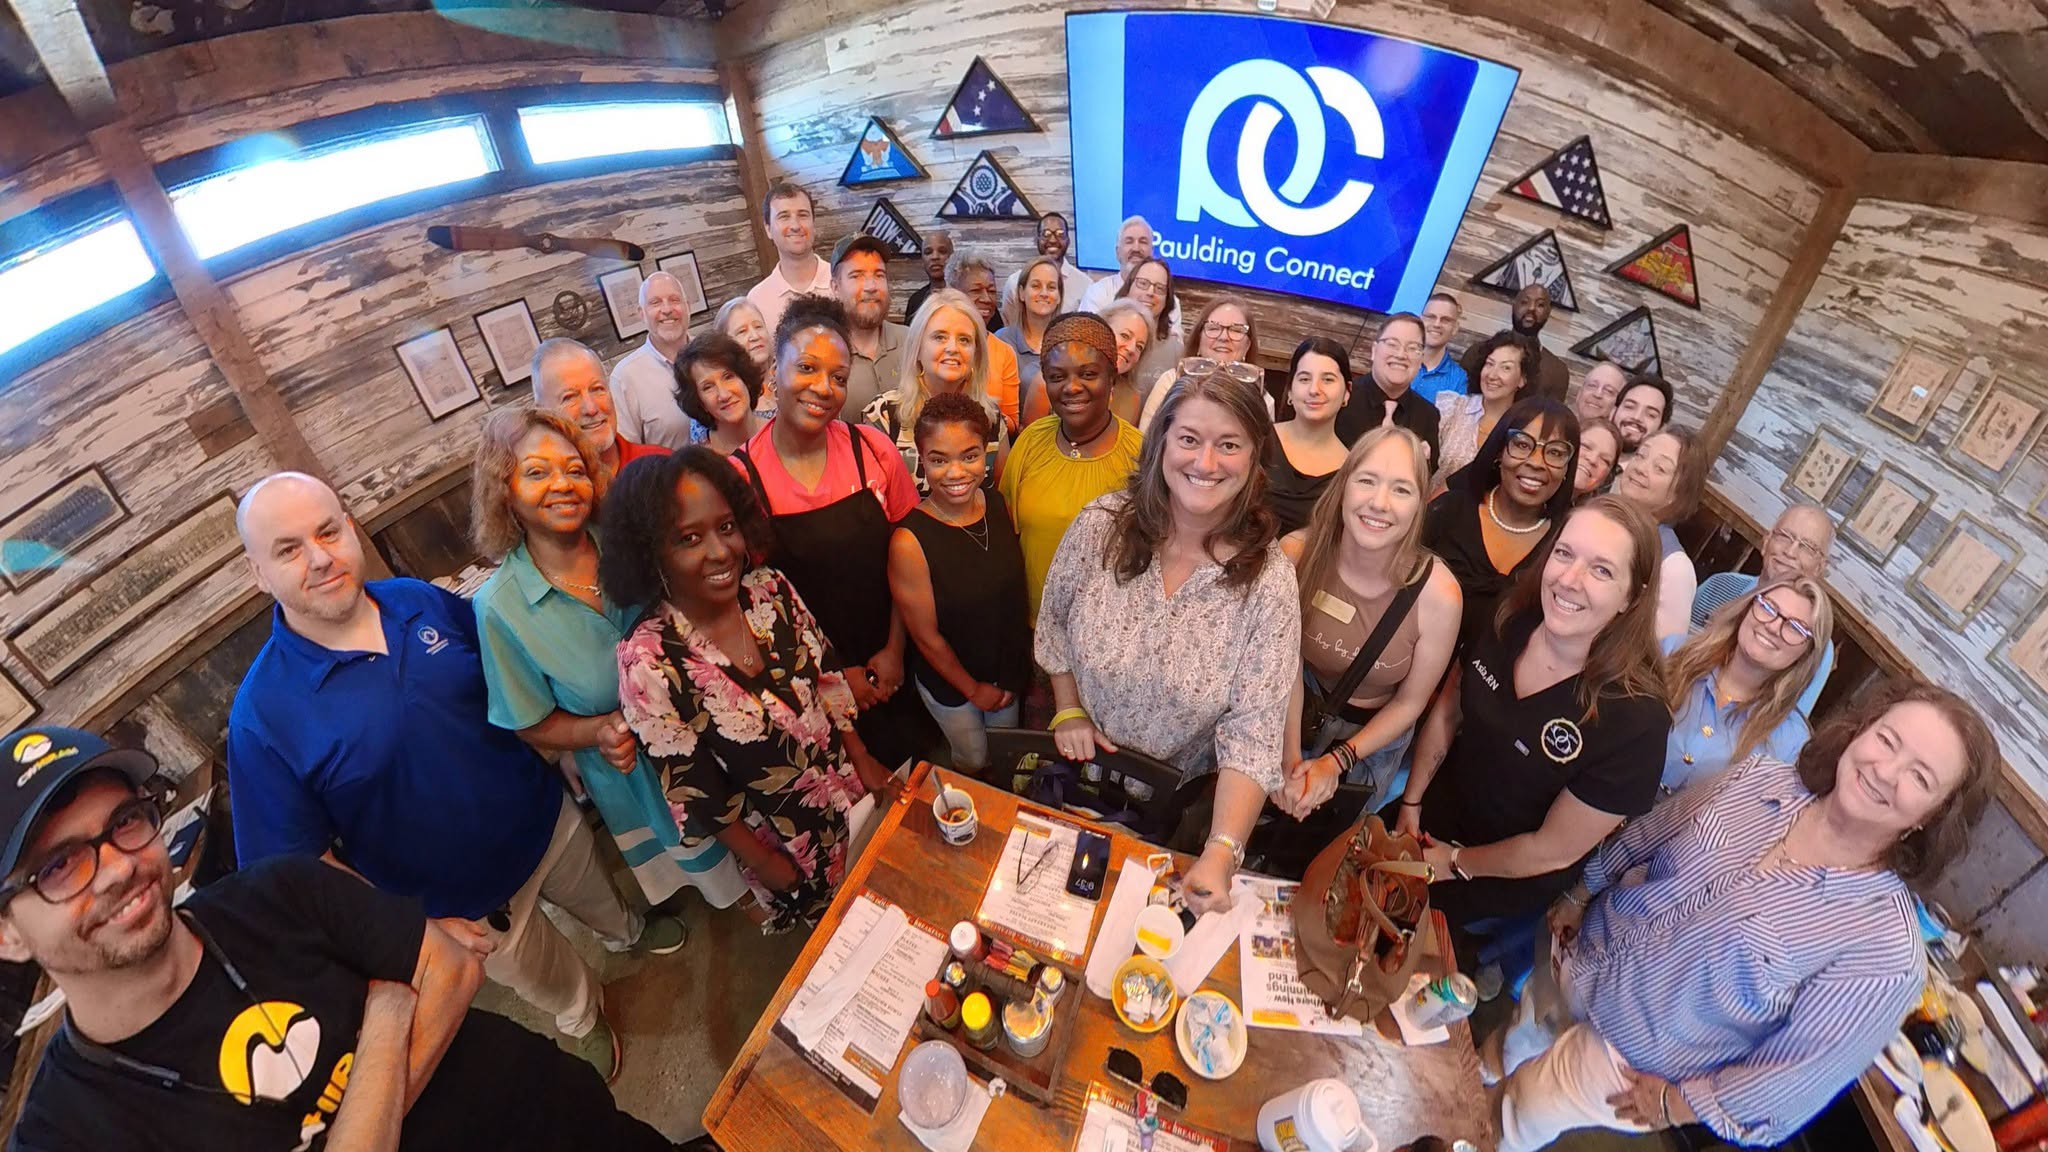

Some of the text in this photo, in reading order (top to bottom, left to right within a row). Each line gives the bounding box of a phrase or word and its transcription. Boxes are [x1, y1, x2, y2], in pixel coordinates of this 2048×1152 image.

[1152, 232, 1375, 290] Paulding Connect
[1268, 973, 1288, 982] End
[1274, 995, 1294, 1005] New
